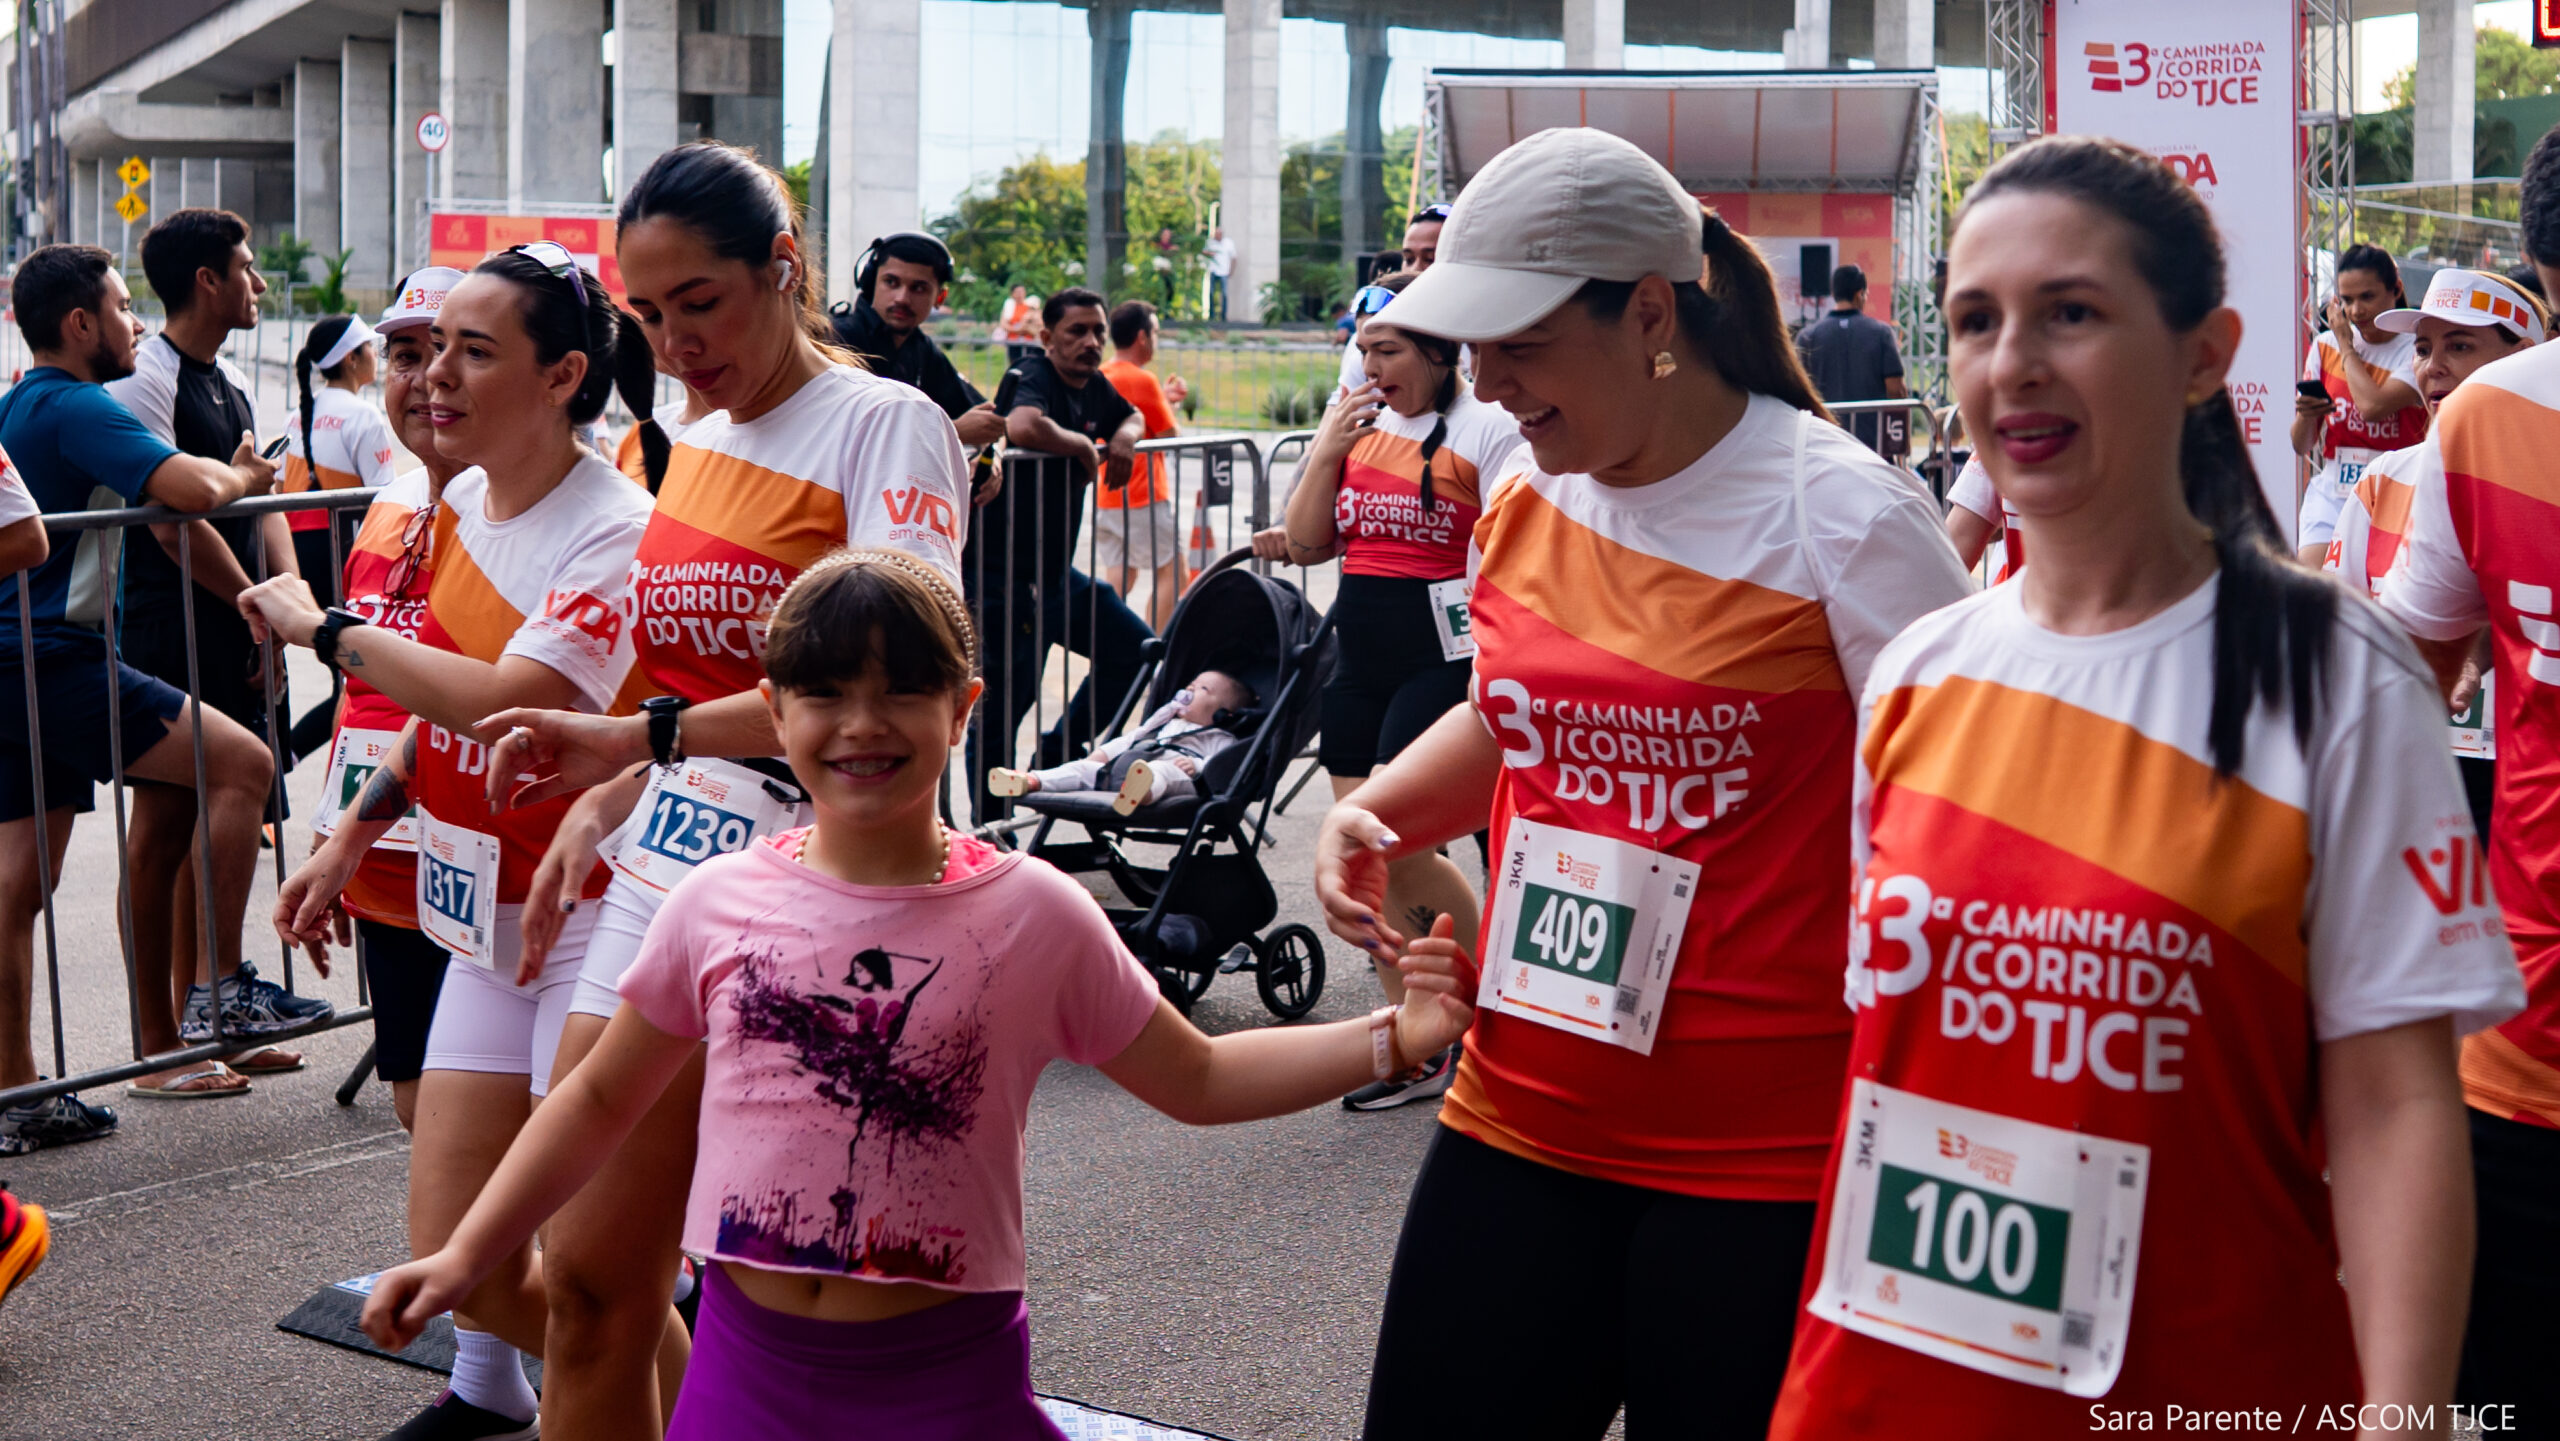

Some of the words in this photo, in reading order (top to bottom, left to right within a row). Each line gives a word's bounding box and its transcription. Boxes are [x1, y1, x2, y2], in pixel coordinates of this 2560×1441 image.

[2156, 56, 2262, 78] /CORRIDA
[2163, 40, 2266, 60] CAMINHADA
[2157, 80, 2187, 99] DO
[2192, 76, 2258, 107] TJCE
[423, 121, 445, 138] 40
[2161, 153, 2218, 186] DA
[2366, 422, 2399, 438] TJCE
[1363, 492, 1458, 514] CAMINHDA
[888, 528, 912, 541] em
[651, 562, 785, 587] CAMINHADA
[645, 615, 680, 646] DO
[681, 617, 768, 659] TJCE
[1553, 700, 1762, 734] CAMINHADA
[1554, 763, 1614, 805] DO
[651, 797, 747, 861] 1239
[424, 855, 476, 920] 1317
[1509, 850, 1526, 889] 3KM
[1529, 894, 1609, 972] 409
[1961, 900, 2214, 968] CAMINHADA
[1941, 934, 2203, 1016] /CORRIDA
[1940, 985, 2017, 1045] DO
[2022, 1000, 2190, 1093] TJCE
[1856, 1119, 1878, 1170] 3KM
[1904, 1180, 2038, 1296] 100
